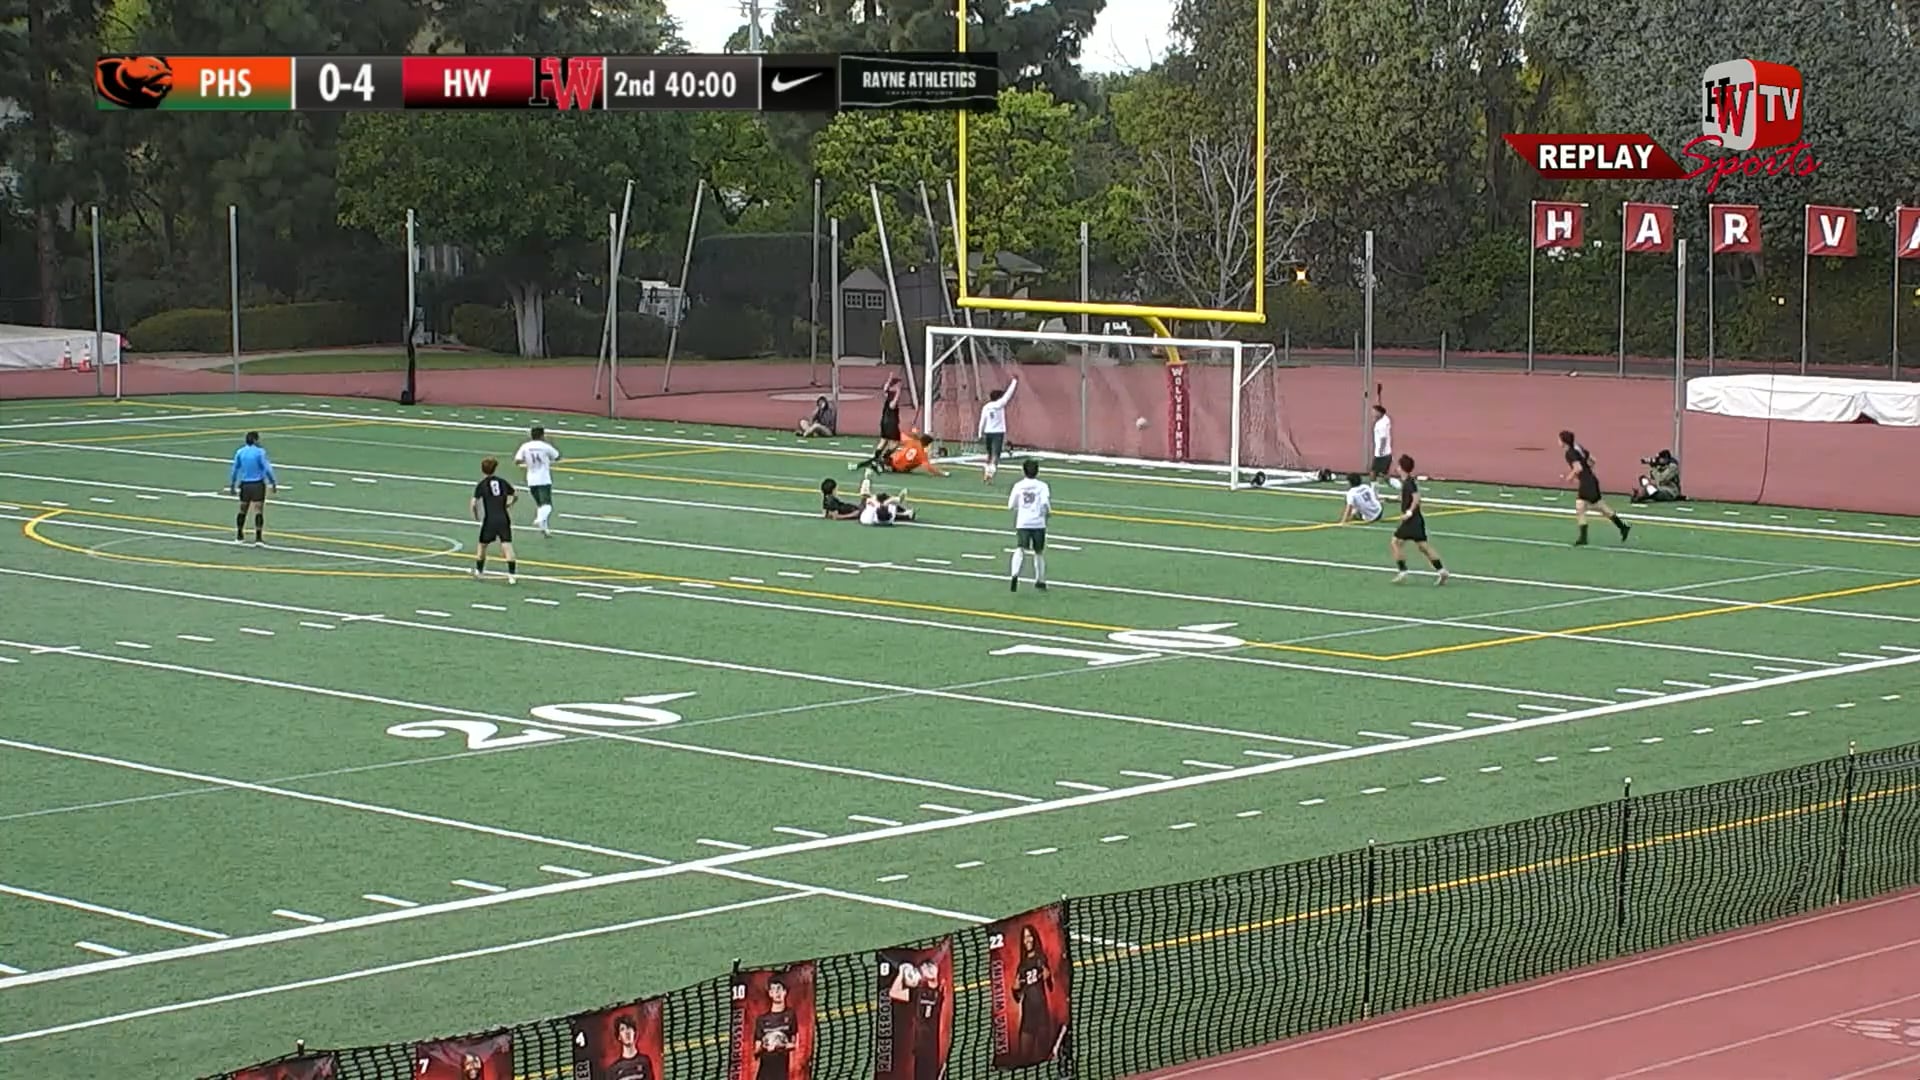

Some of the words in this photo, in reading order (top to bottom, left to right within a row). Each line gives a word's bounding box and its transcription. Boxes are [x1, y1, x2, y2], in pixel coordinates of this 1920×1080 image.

[1546, 209, 1573, 241] H
[1635, 212, 1662, 245] A
[1723, 212, 1749, 245] R
[1820, 213, 1845, 247] V
[1171, 366, 1185, 459] WOLVERINES
[989, 629, 1246, 666] 10
[386, 701, 682, 750] 20
[989, 934, 1005, 950] 22
[732, 984, 747, 1001] 10
[575, 1031, 586, 1048] 4
[418, 1057, 430, 1075] 7
